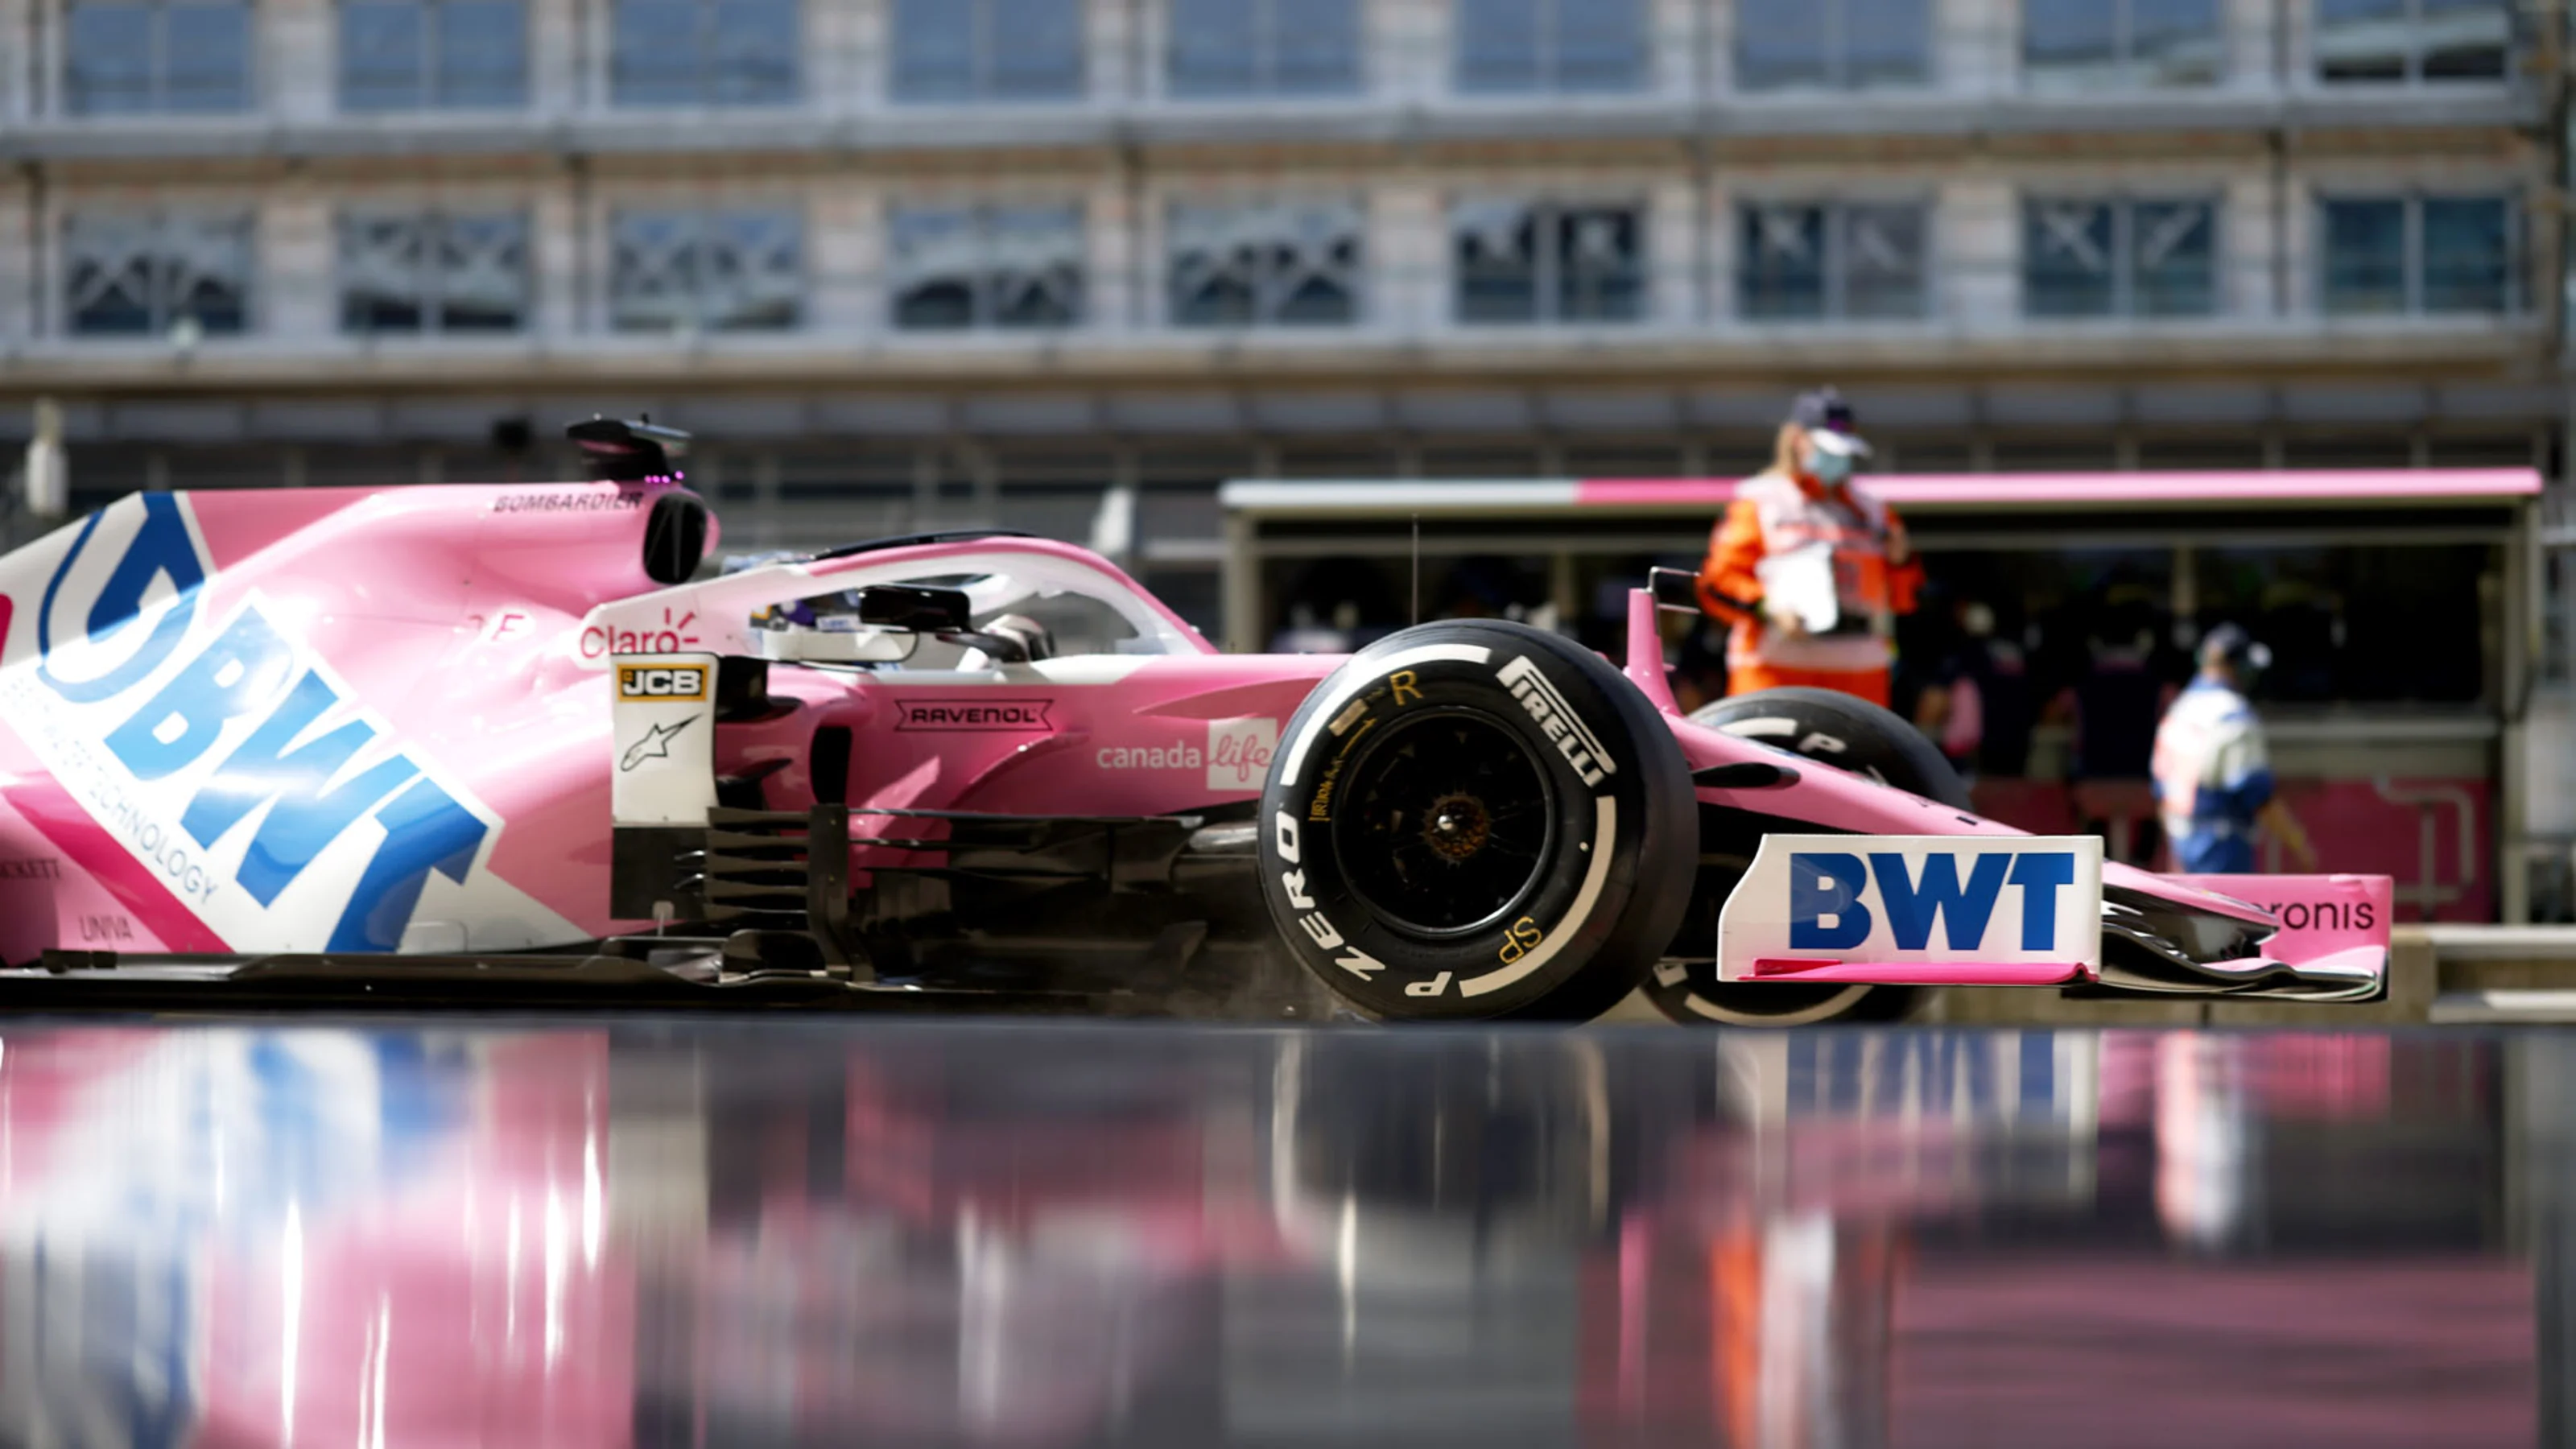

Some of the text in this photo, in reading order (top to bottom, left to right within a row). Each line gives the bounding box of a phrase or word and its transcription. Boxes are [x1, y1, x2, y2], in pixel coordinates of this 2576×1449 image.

[493, 491, 643, 512] BOMBARDIER
[580, 626, 679, 659] Claro
[623, 670, 702, 696] JCB
[910, 708, 1038, 724] RAVENOL
[1495, 654, 1617, 787] PIRELLI
[103, 603, 489, 954] BWT
[1097, 734, 1272, 783] canada life
[87, 765, 220, 906] ECHNOLOGY
[1789, 852, 2074, 952] BWT
